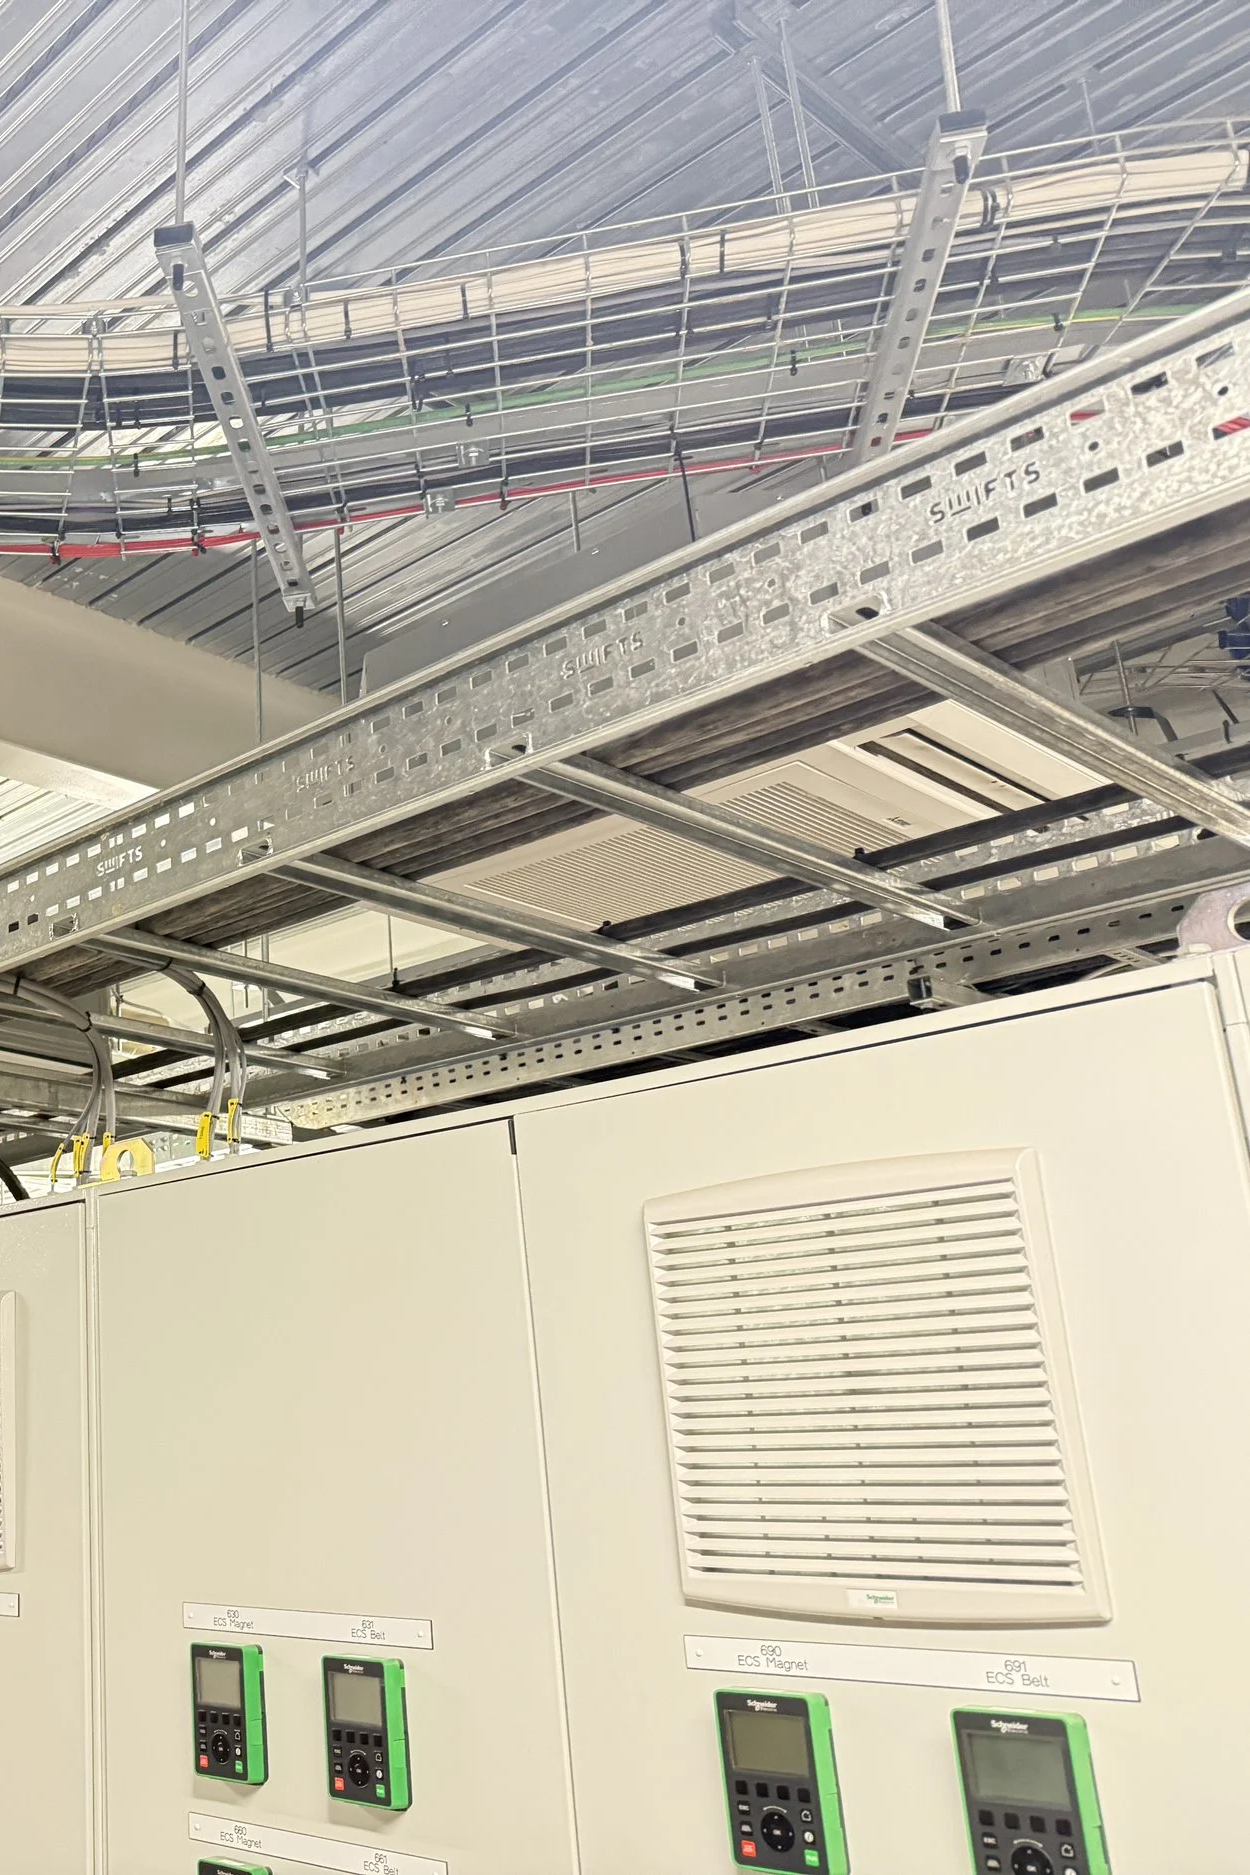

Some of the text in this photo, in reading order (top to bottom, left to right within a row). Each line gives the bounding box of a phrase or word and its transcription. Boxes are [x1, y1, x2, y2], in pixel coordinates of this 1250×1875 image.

[929, 461, 1040, 524] SWIFTS
[562, 631, 643, 680] SWIFTS
[97, 845, 143, 877] SWIFTS
[227, 1609, 239, 1619] 630
[213, 1617, 254, 1630] ECS Magnet
[361, 1620, 374, 1629] 631
[351, 1628, 386, 1640] ECS Belt
[760, 1644, 782, 1656] 690
[737, 1655, 808, 1672] ECS Magnet
[1004, 1659, 1027, 1672] 691
[986, 1671, 1050, 1688] ECS Belt
[747, 1700, 778, 1708] Schneider
[990, 1719, 1029, 1730] Schneider
[234, 1825, 247, 1836] 660
[220, 1831, 262, 1848] ECS Magnet
[375, 1852, 388, 1864] 661
[363, 1860, 380, 1873] ECS
